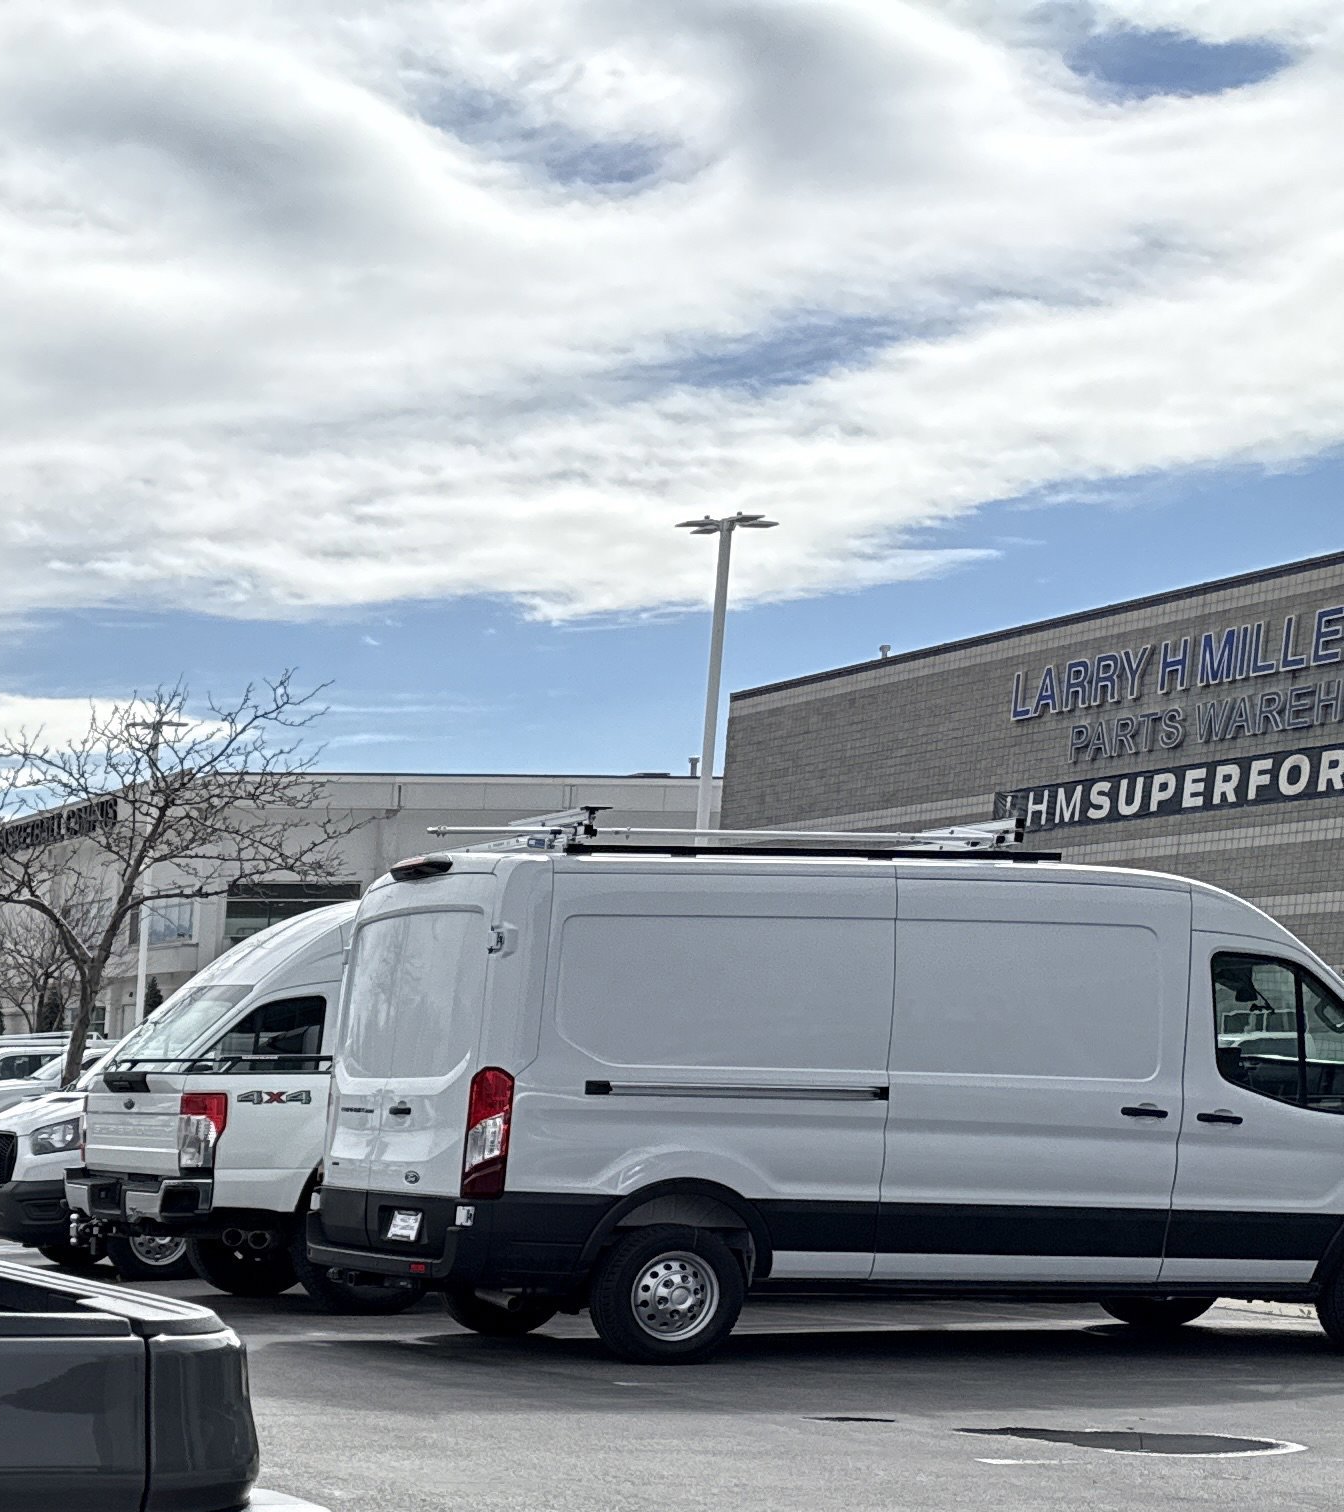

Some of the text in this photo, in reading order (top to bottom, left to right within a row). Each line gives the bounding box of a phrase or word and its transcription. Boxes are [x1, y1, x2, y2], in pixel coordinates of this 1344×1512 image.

[1011, 606, 1344, 721] LARRY H MILLE
[1068, 679, 1344, 763] PARTS WAREH
